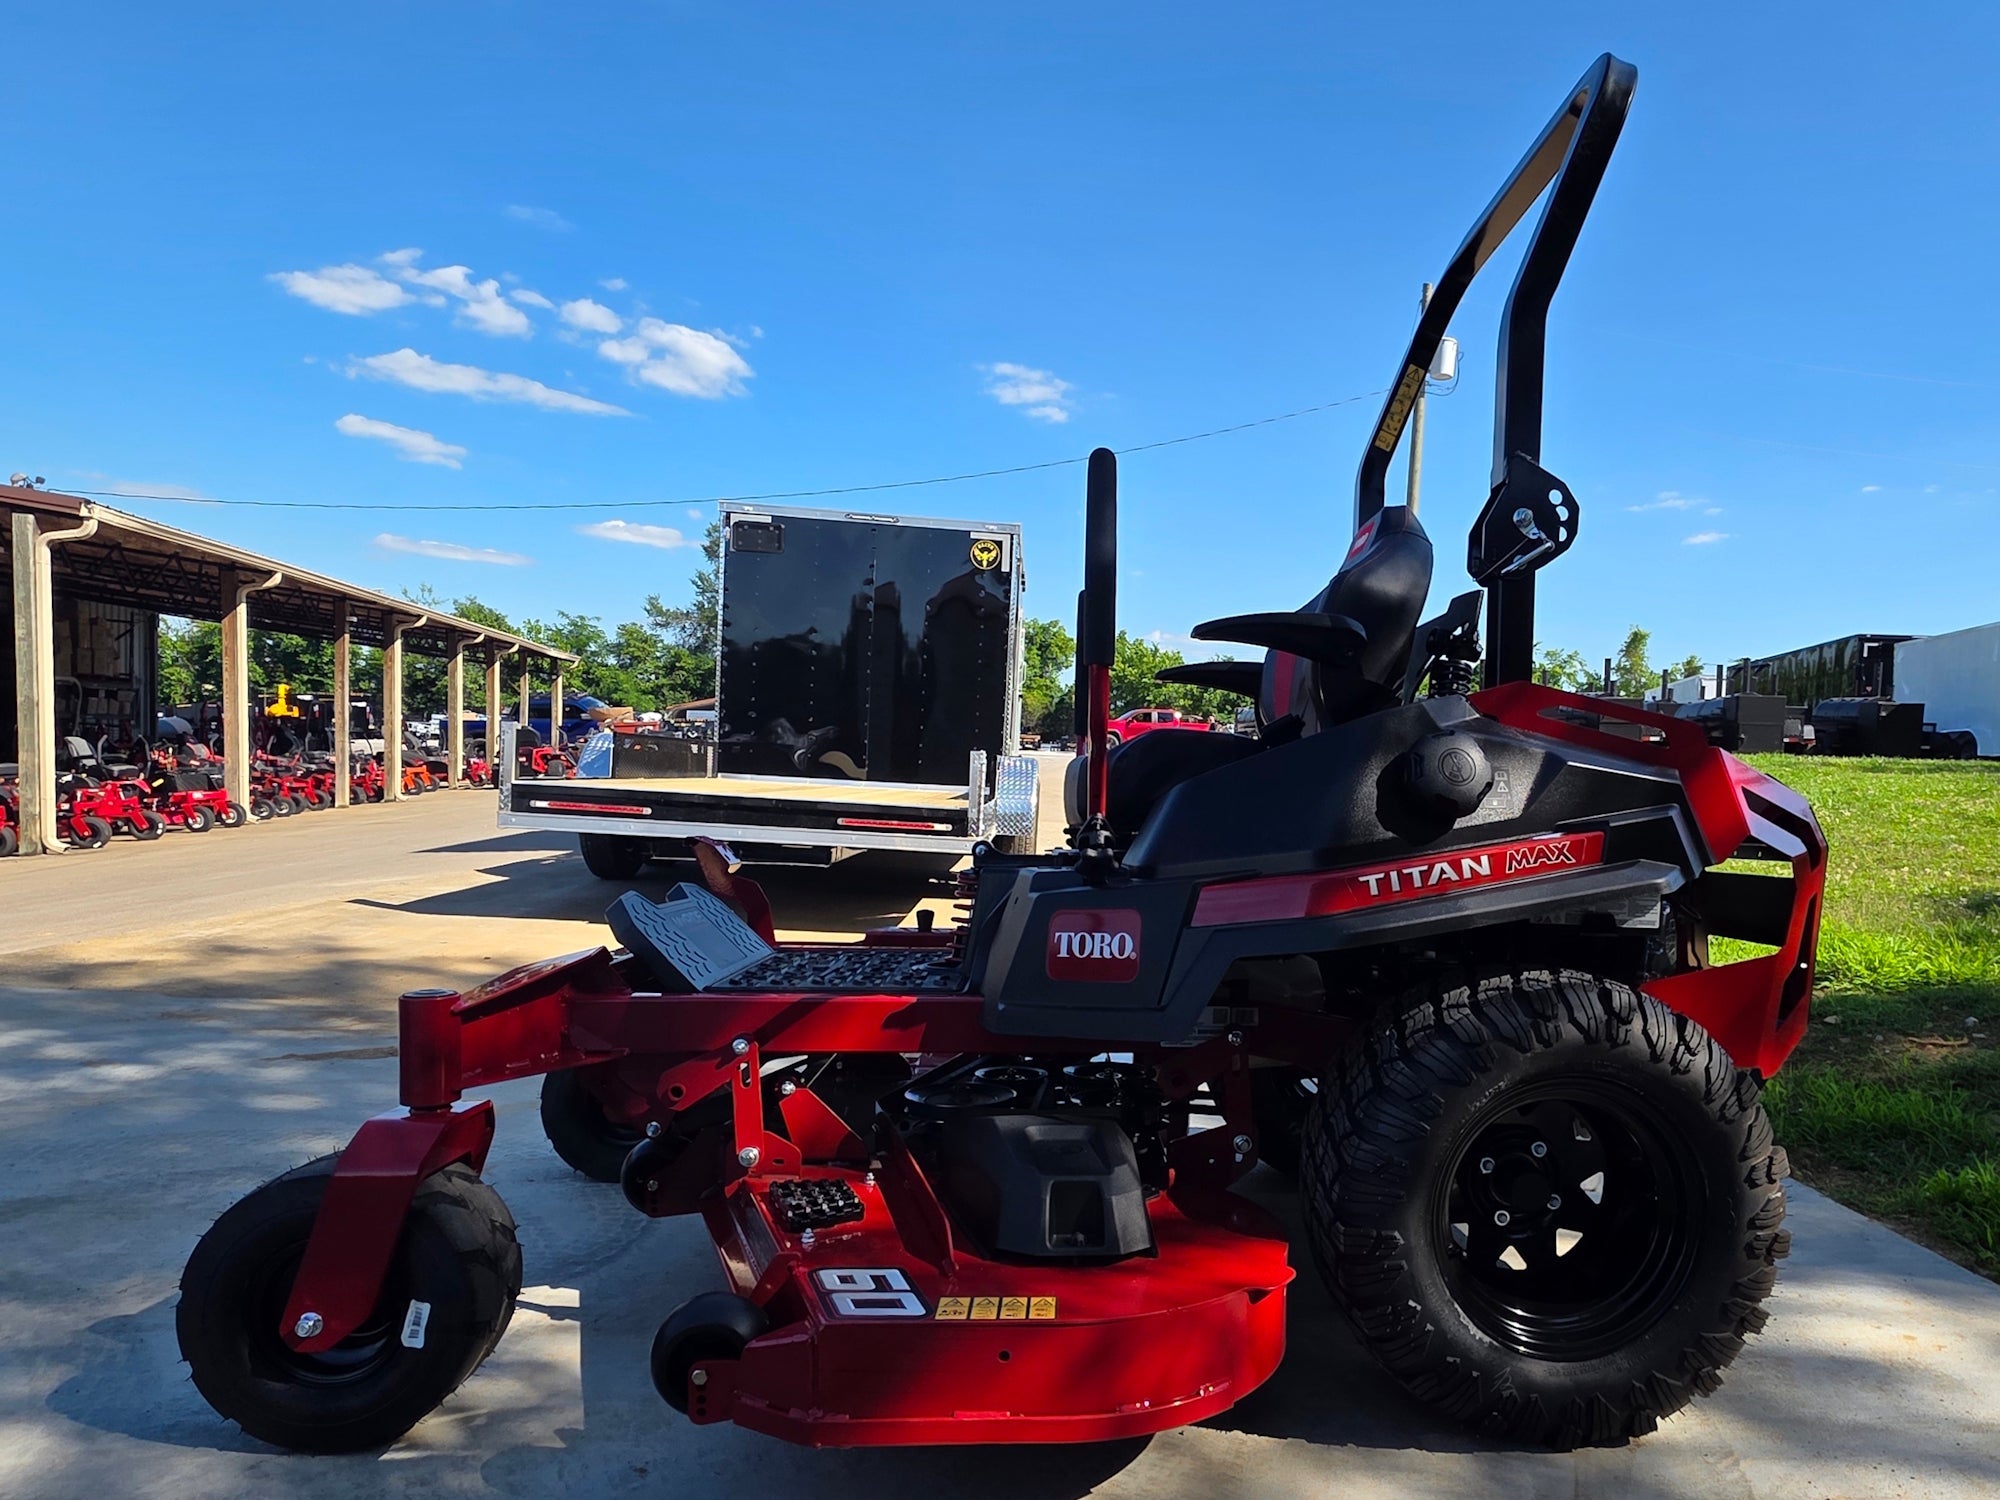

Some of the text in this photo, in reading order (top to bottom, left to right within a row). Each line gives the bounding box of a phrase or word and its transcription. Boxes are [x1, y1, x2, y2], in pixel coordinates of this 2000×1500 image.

[1357, 840, 1576, 896] TITAN MAX
[1053, 931, 1134, 960] TORO
[815, 1268, 927, 1316] 60
